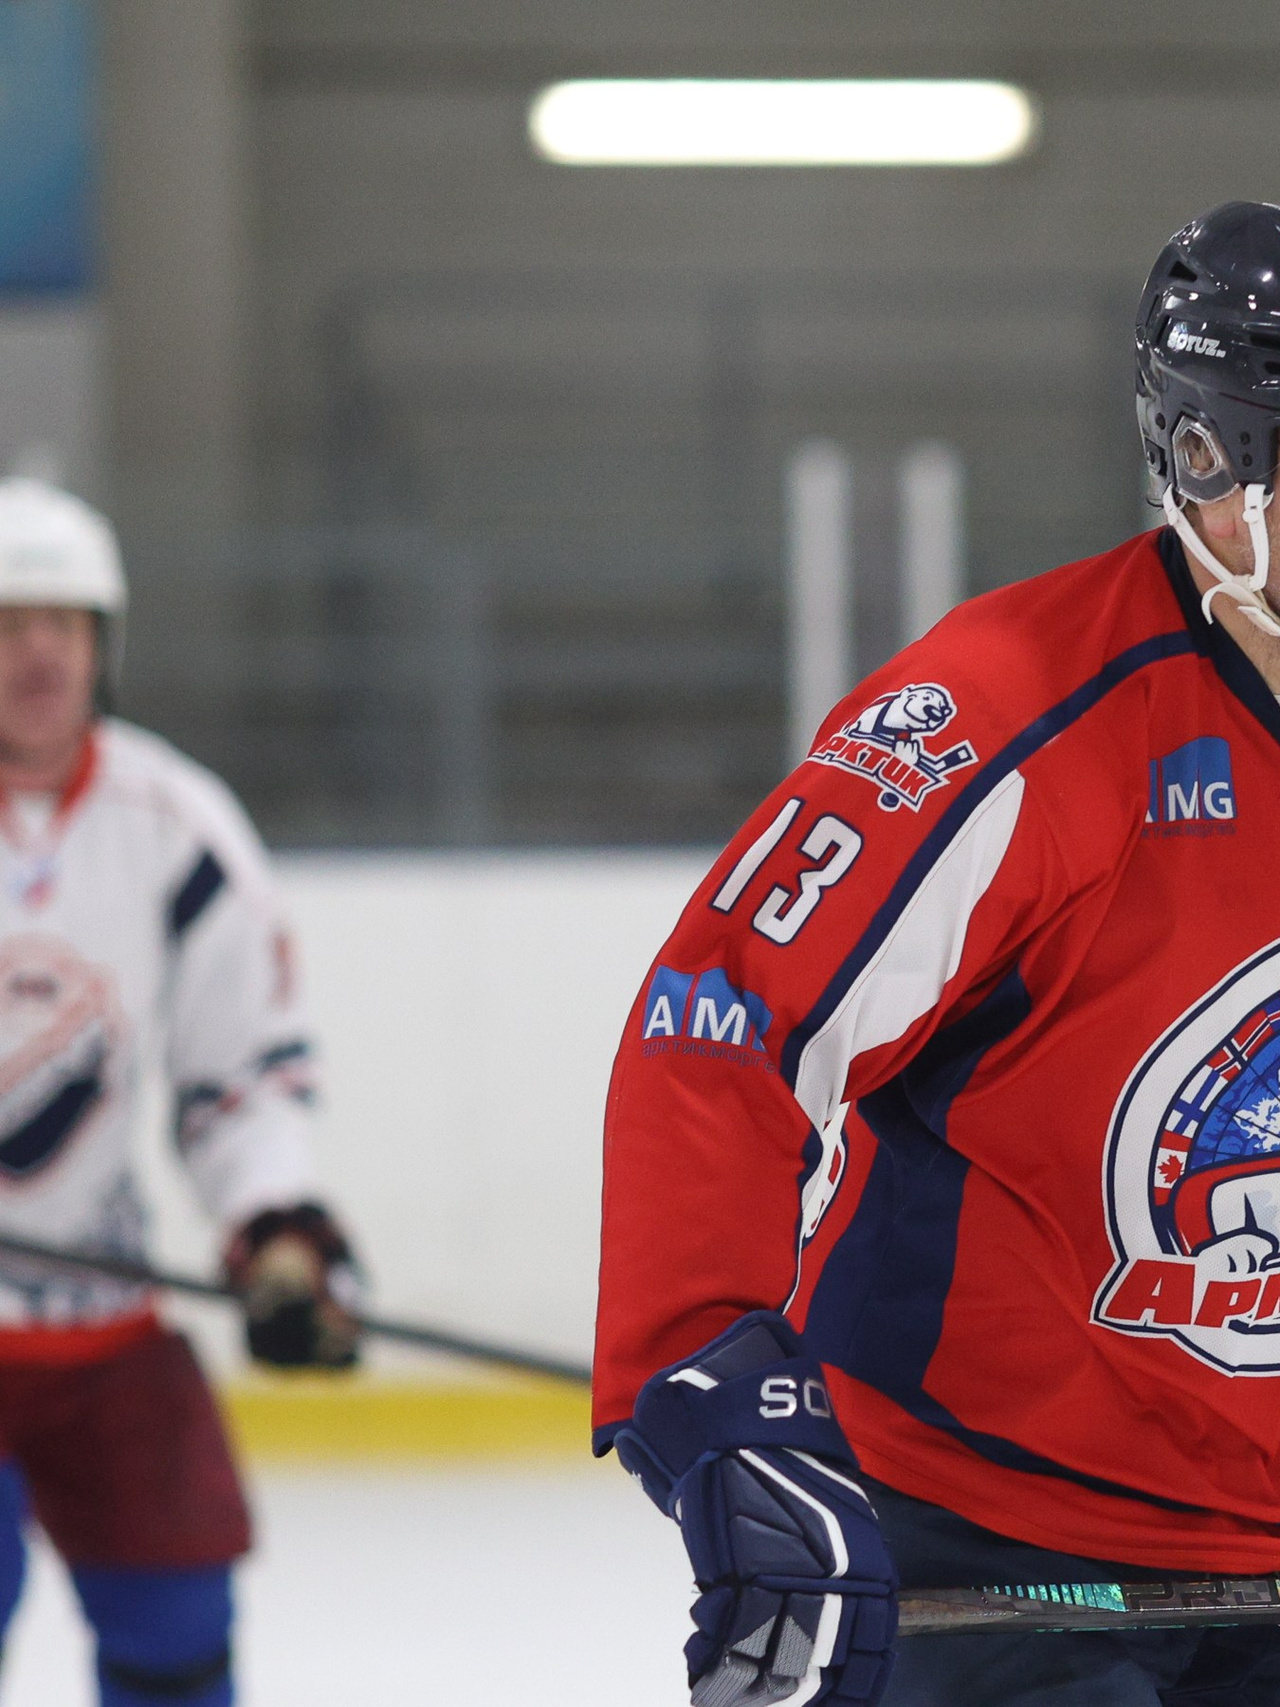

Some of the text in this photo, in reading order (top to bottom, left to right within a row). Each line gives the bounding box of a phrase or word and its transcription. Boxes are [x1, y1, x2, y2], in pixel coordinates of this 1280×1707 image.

[1166, 331, 1220, 357] SOYUZ
[1144, 780, 1235, 823] MG
[710, 796, 864, 948] 13
[643, 994, 766, 1050] AM
